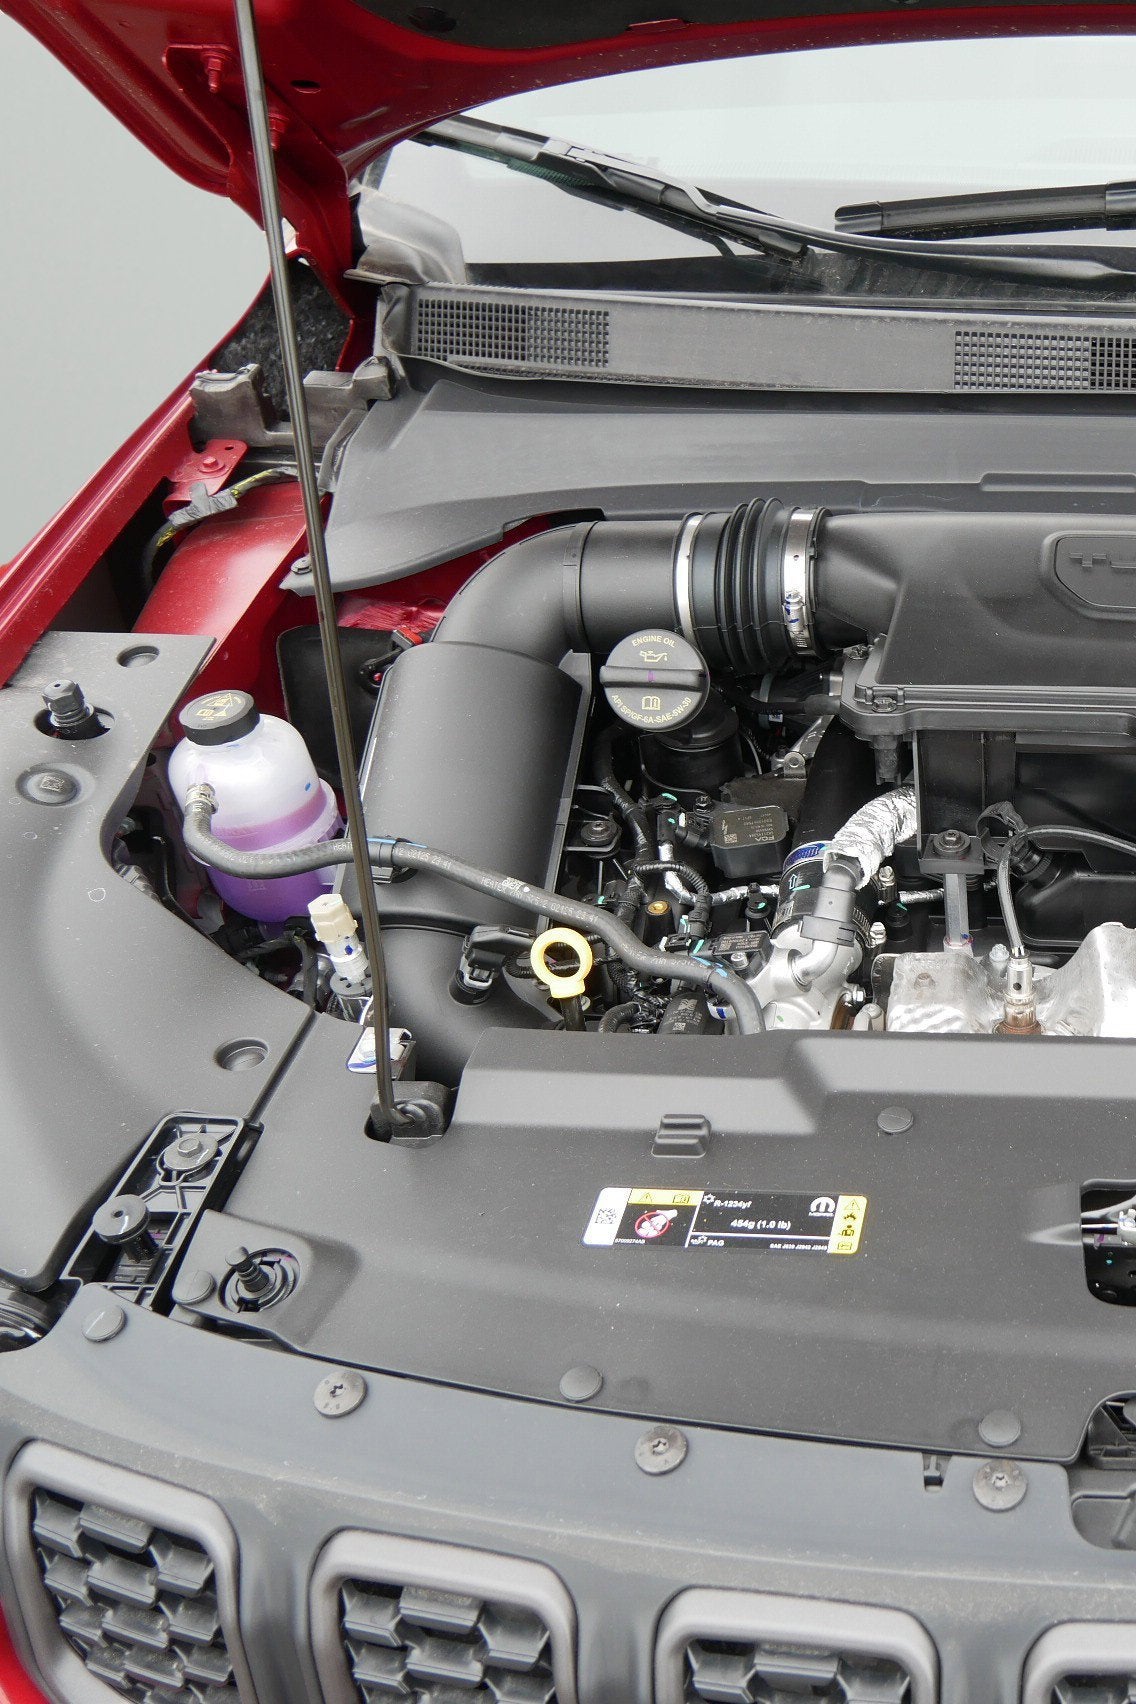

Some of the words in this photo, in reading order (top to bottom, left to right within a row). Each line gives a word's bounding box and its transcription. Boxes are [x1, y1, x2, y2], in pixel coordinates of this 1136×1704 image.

[632, 636, 662, 646] ENGINE
[663, 637, 677, 648] OIL
[611, 694, 622, 708] API
[714, 1200, 752, 1210] R-1234yf
[730, 1218, 756, 1230] 454g
[757, 1219, 776, 1230] (1.0
[777, 1220, 792, 1230] lb)
[707, 1239, 725, 1247] PAG
